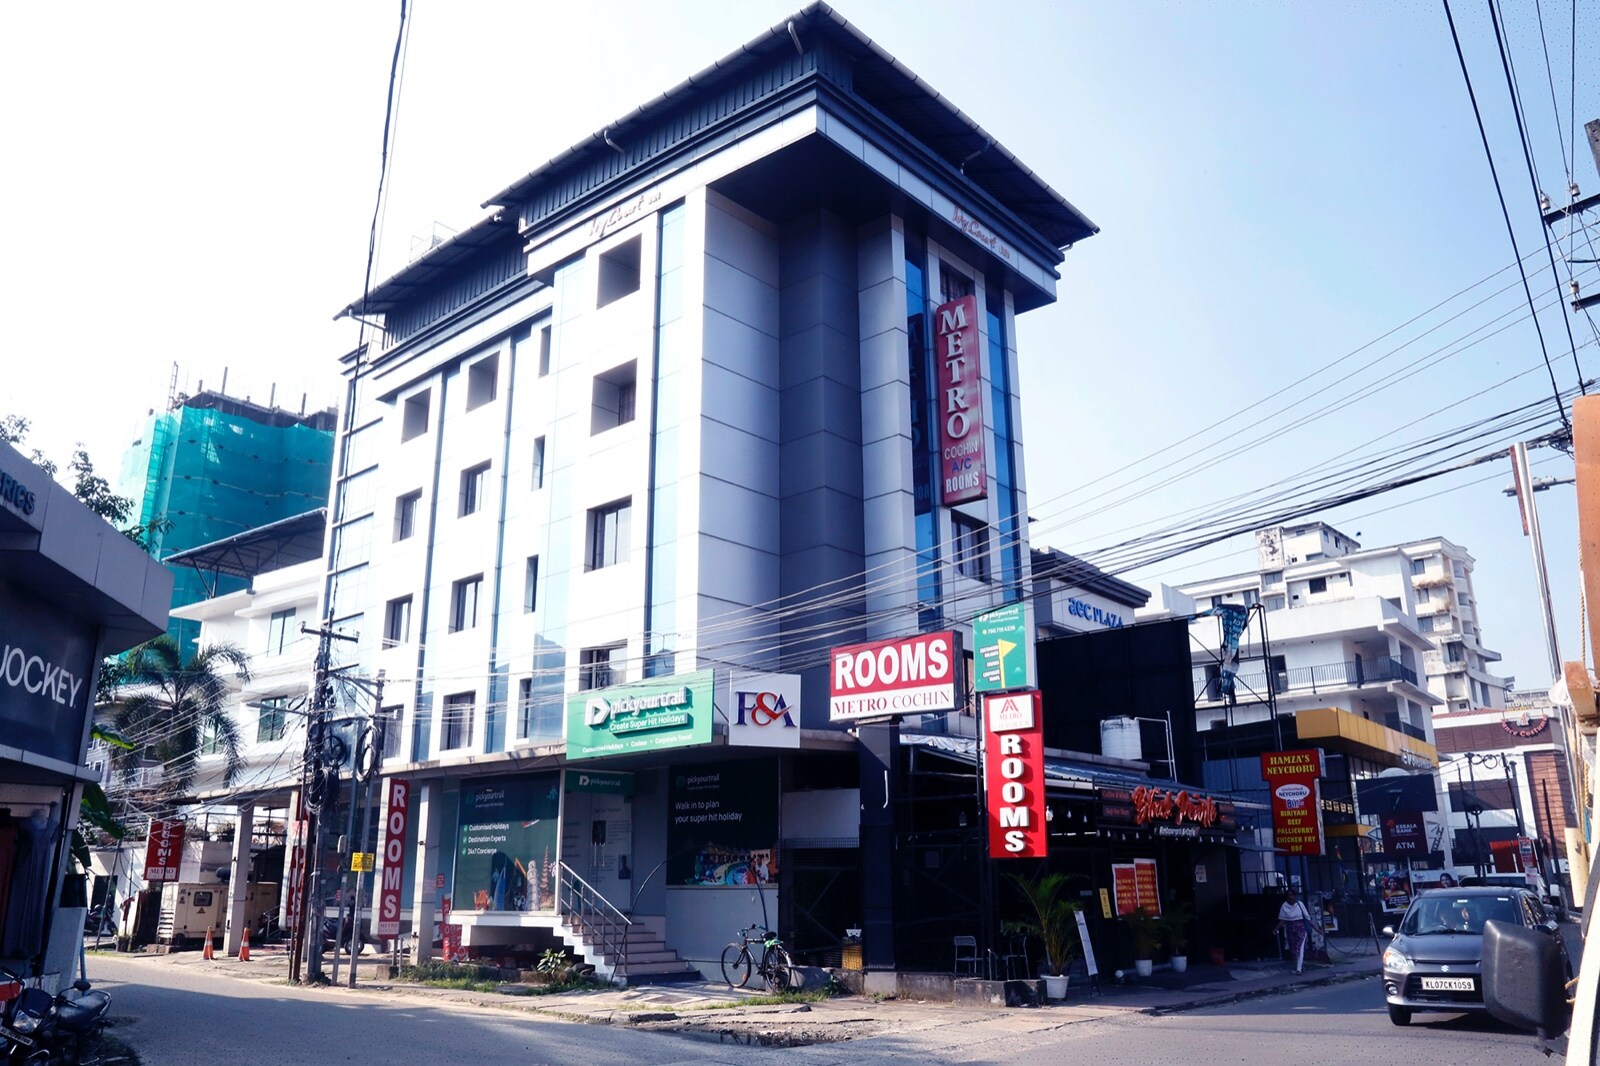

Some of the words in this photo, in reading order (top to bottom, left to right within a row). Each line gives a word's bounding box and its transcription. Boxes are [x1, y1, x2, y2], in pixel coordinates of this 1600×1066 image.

[940, 304, 971, 439] METRO
[944, 441, 979, 460] COCHIN
[951, 458, 972, 473] A/C
[945, 472, 979, 494] ROOMS
[835, 639, 949, 690] ROOMS
[0, 644, 83, 708] JOCKEY
[610, 687, 686, 720] pickyourtrail
[735, 691, 794, 728] F&A
[834, 696, 888, 715] METRO
[893, 690, 951, 708] COCHIN
[609, 720, 630, 732] Create
[629, 718, 647, 729] Super
[647, 716, 657, 726] Hit
[657, 713, 685, 724] Holidays
[1000, 712, 1022, 720] METRO
[1270, 754, 1310, 765] HAMZA'S
[1267, 764, 1315, 775] NEYCHORU
[1000, 734, 1030, 852] ROOMS
[675, 802, 690, 810] Walk
[691, 801, 697, 809] in
[698, 801, 705, 809] to
[705, 799, 720, 810] plan
[675, 816, 689, 825] your
[690, 814, 708, 824] super
[708, 813, 718, 822] hit
[718, 811, 743, 823] holiday
[490, 835, 507, 843] Experts
[1396, 841, 1415, 850] ATM
[384, 784, 406, 919] ROOMS
[1425, 979, 1472, 990] KL07CK1059
